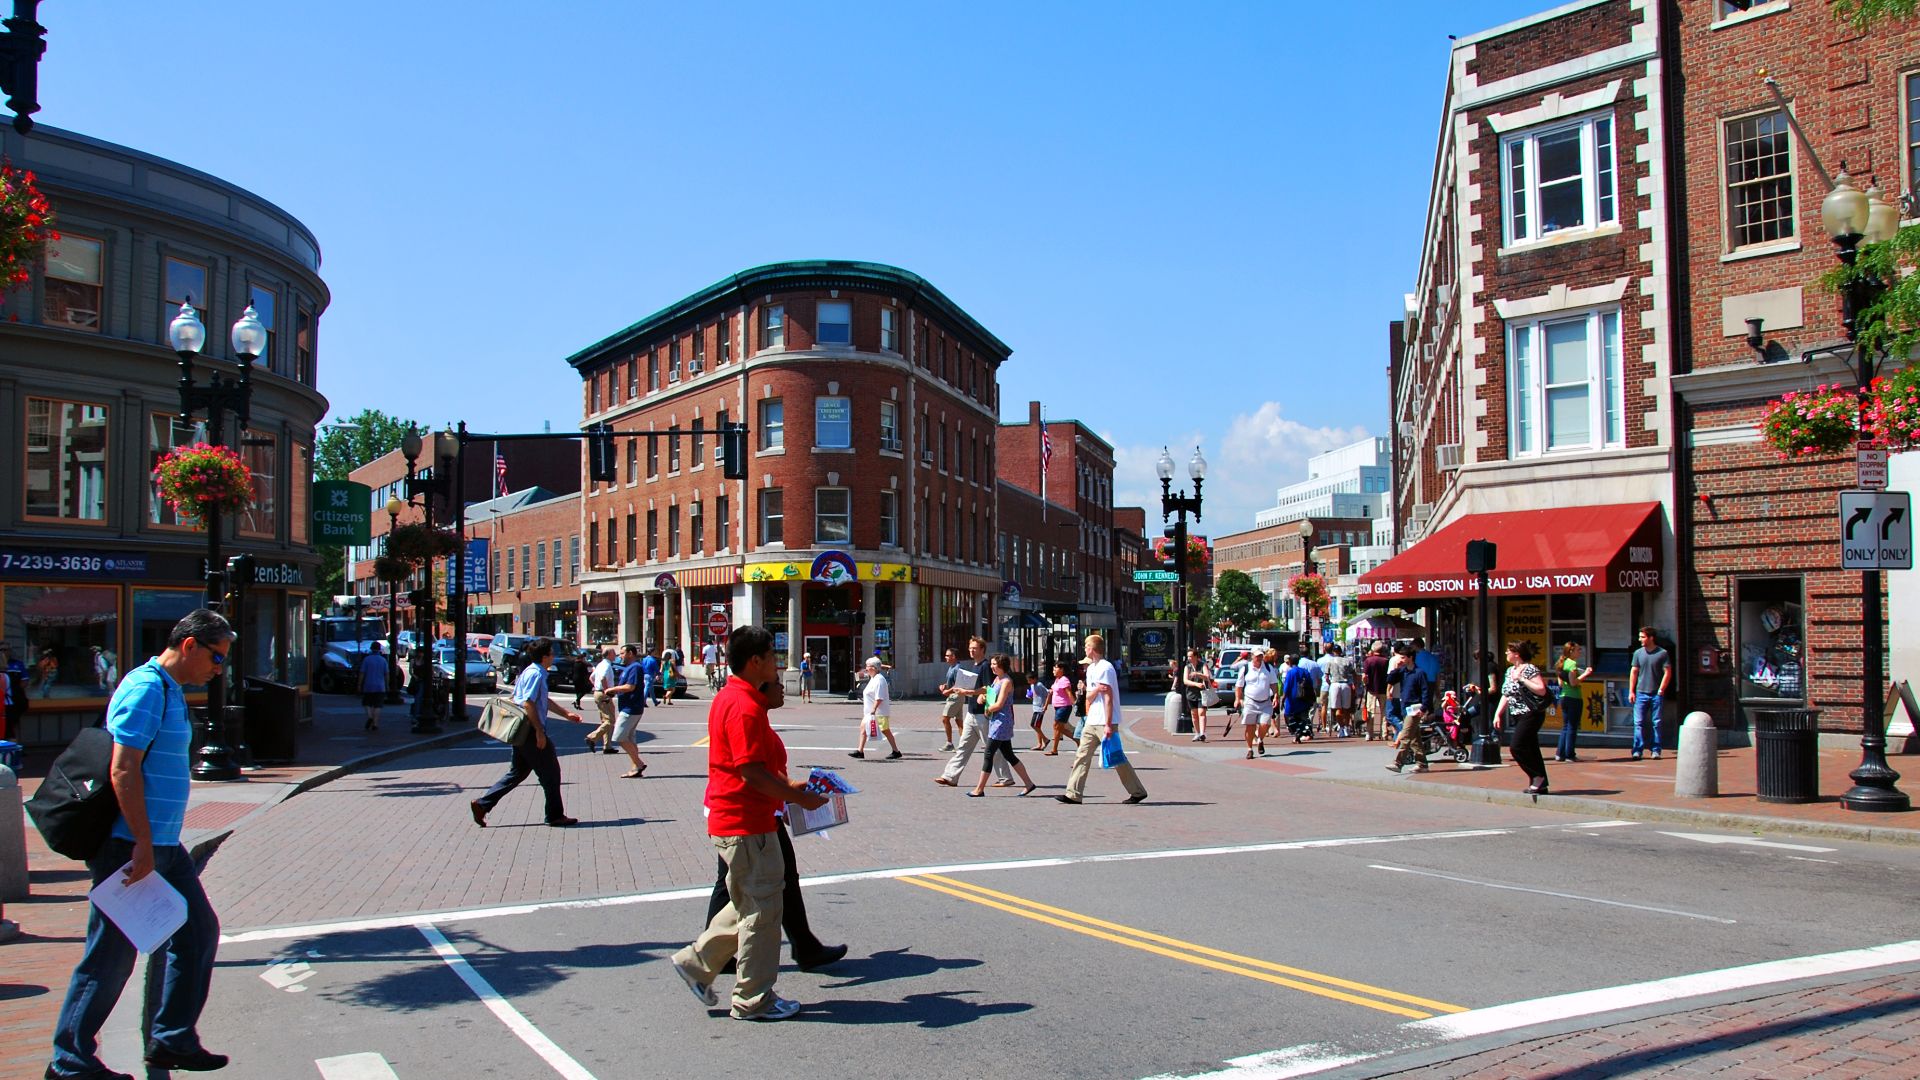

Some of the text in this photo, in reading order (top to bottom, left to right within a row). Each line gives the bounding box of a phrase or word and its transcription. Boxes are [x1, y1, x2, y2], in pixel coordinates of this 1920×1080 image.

[313, 510, 364, 522] Citizens
[323, 524, 355, 535] Bank
[1845, 549, 1908, 561] ONLY ONLY
[281, 563, 303, 584] Bank
[475, 557, 486, 591] TERS
[1618, 570, 1659, 587] CORNER
[1374, 582, 1403, 593] GLOBE
[1418, 579, 1463, 591] BOSTON
[1526, 576, 1551, 588] USA
[1554, 574, 1594, 587] TODAY
[1506, 615, 1544, 625] PHONE
[1506, 626, 1544, 635] CARDS
